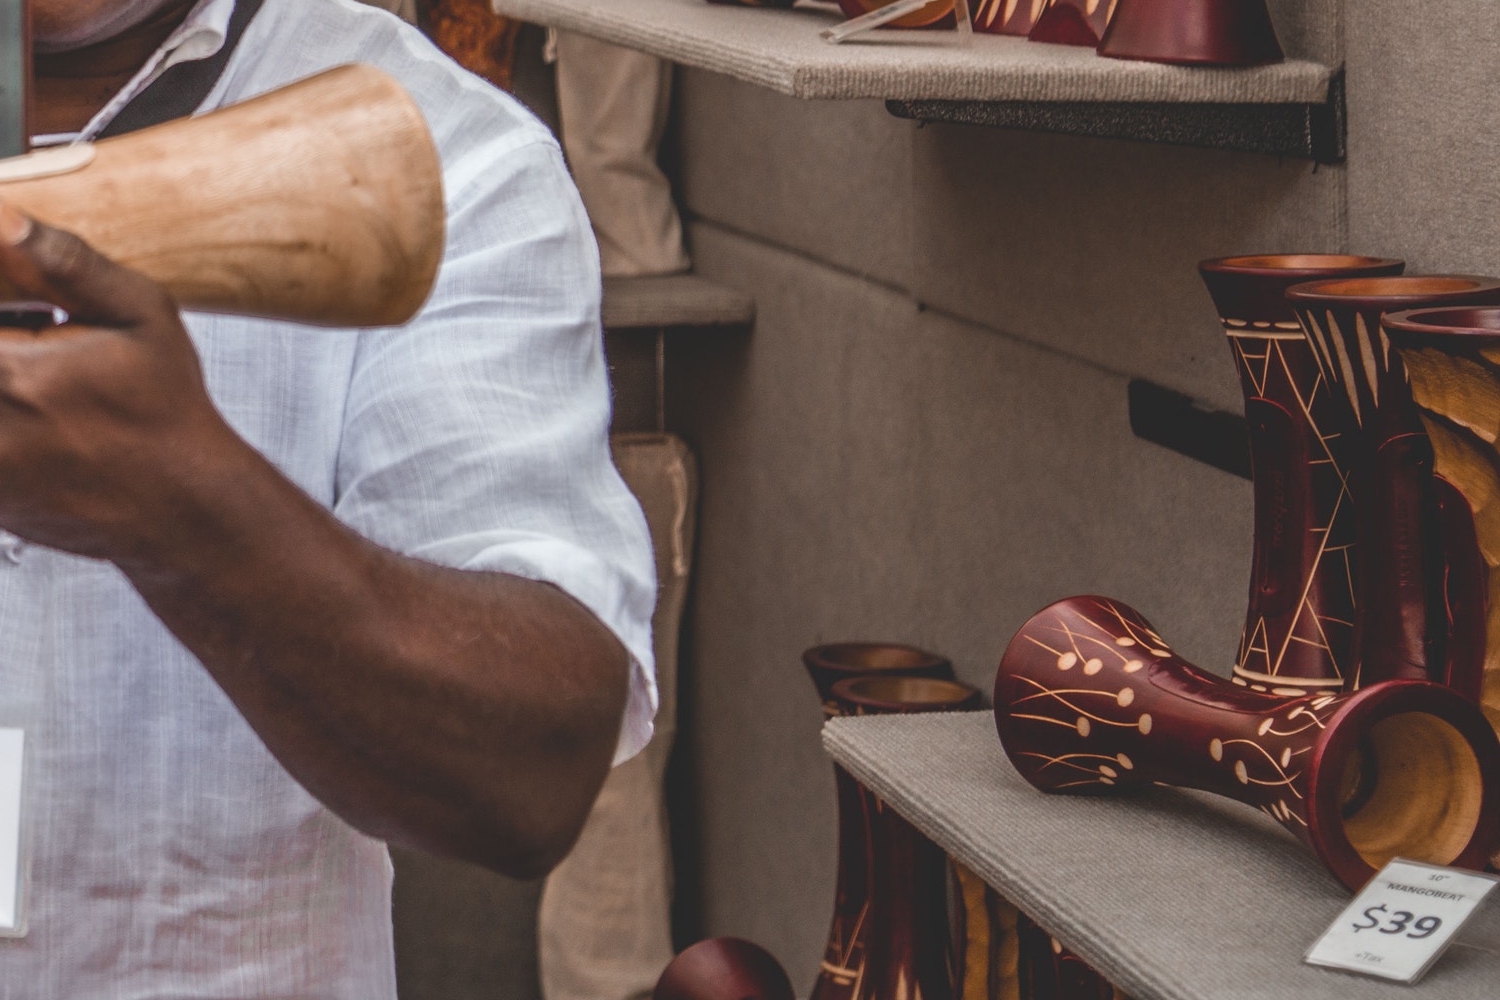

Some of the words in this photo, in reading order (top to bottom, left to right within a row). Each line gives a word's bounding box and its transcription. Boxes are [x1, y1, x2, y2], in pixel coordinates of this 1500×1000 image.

[1387, 882, 1467, 902] MANGOBEAT
[1352, 903, 1443, 940] $39
[1355, 951, 1385, 963] +Tax
